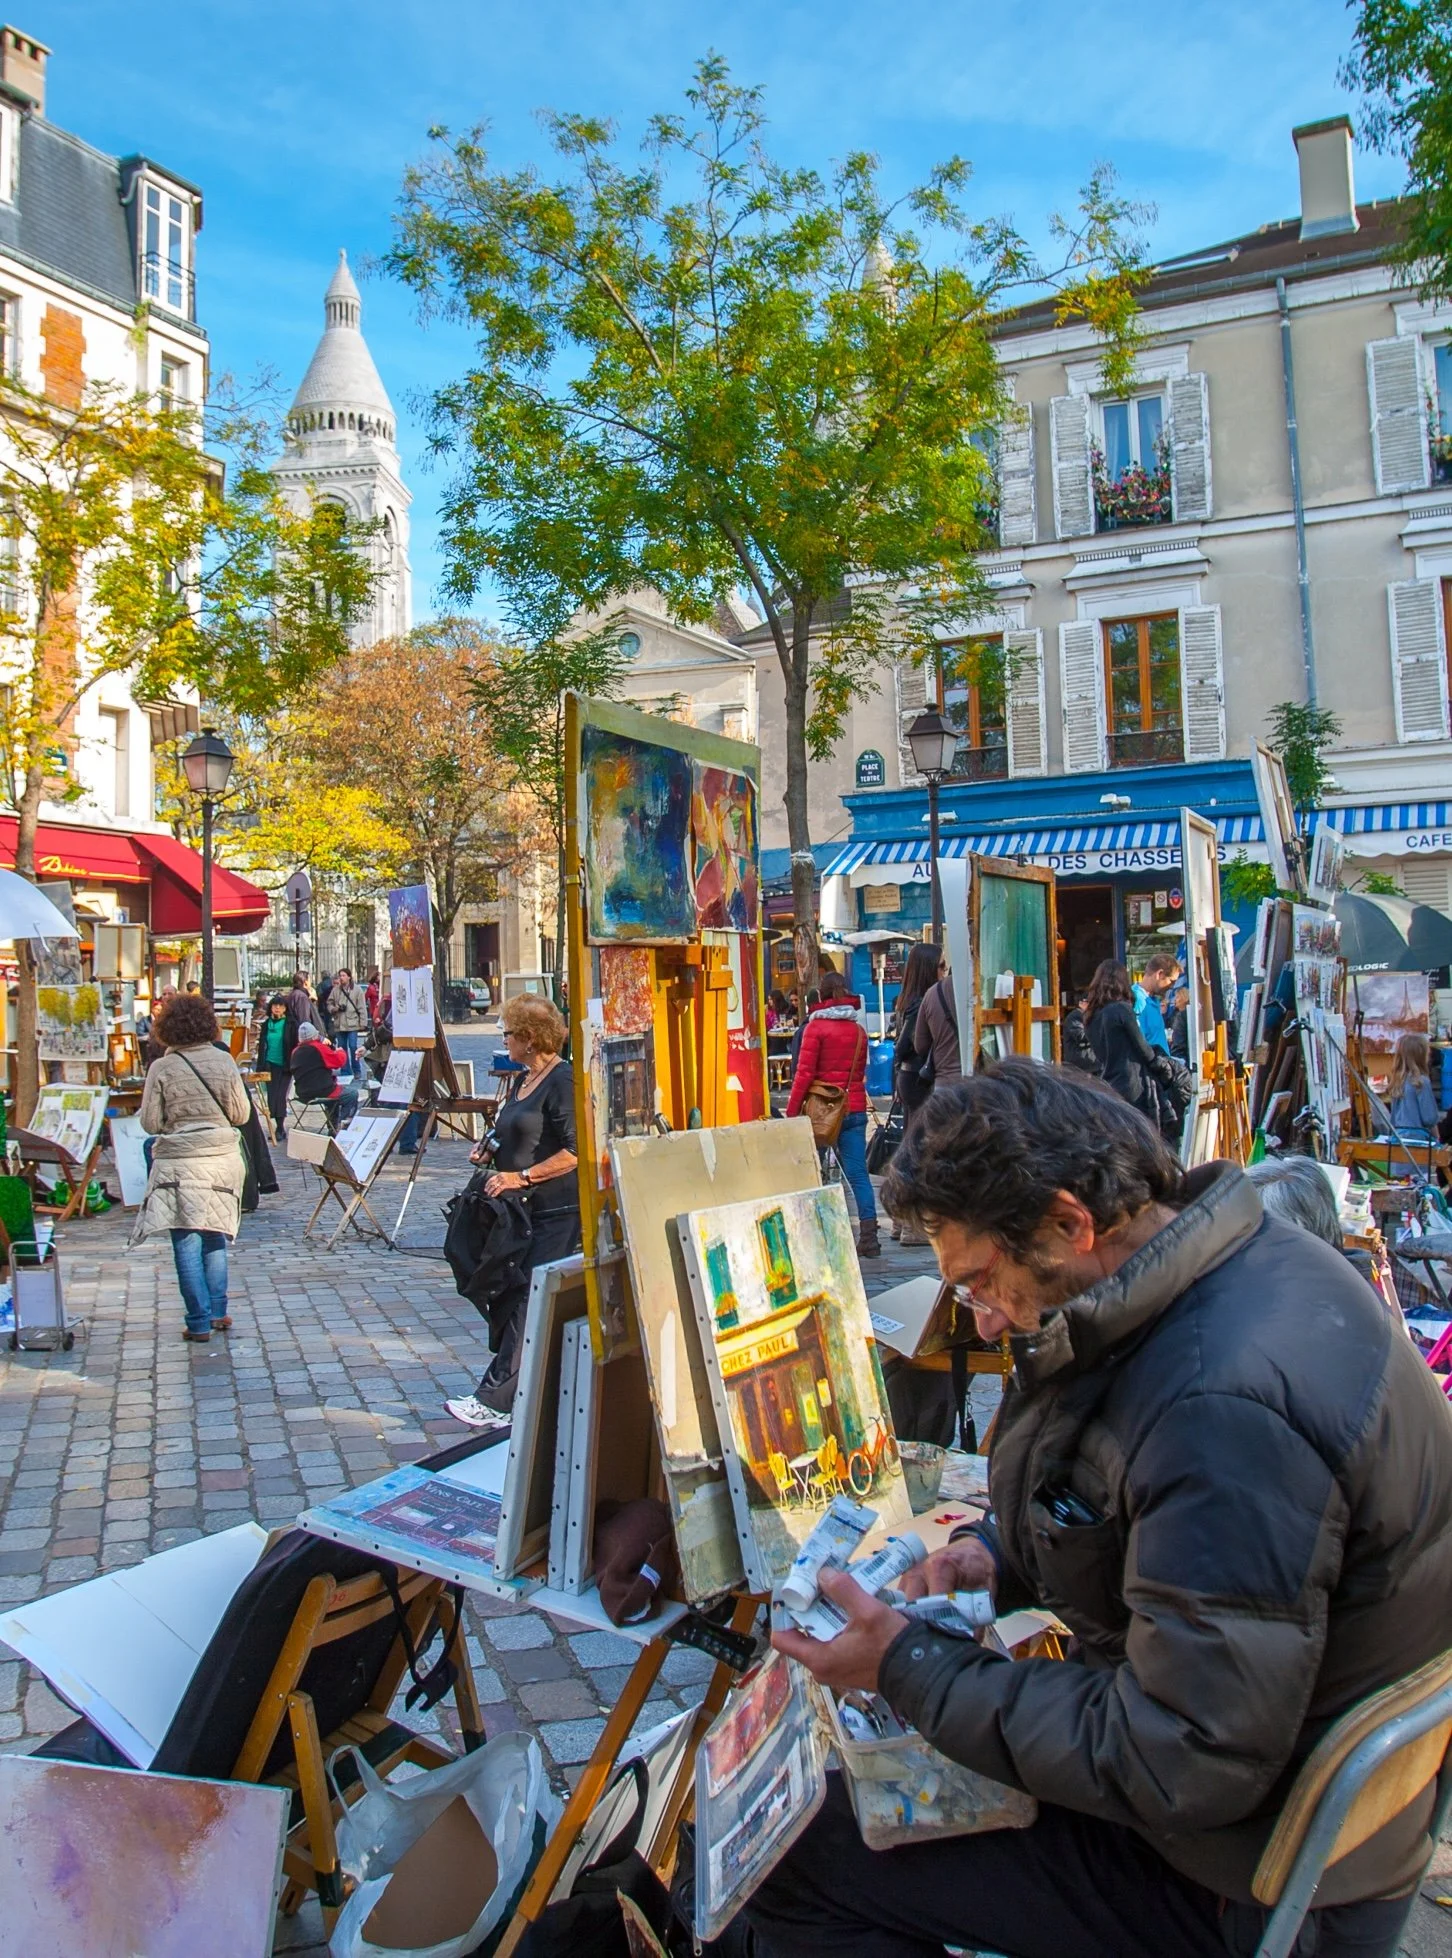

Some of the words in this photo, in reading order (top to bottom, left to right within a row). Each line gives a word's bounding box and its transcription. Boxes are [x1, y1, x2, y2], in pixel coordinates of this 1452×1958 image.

[861, 763, 879, 771] PLACE
[860, 774, 880, 782] TERTRE
[1048, 854, 1087, 870] DES
[721, 1351, 752, 1372] CHEZ
[757, 1337, 789, 1359] PAUL
